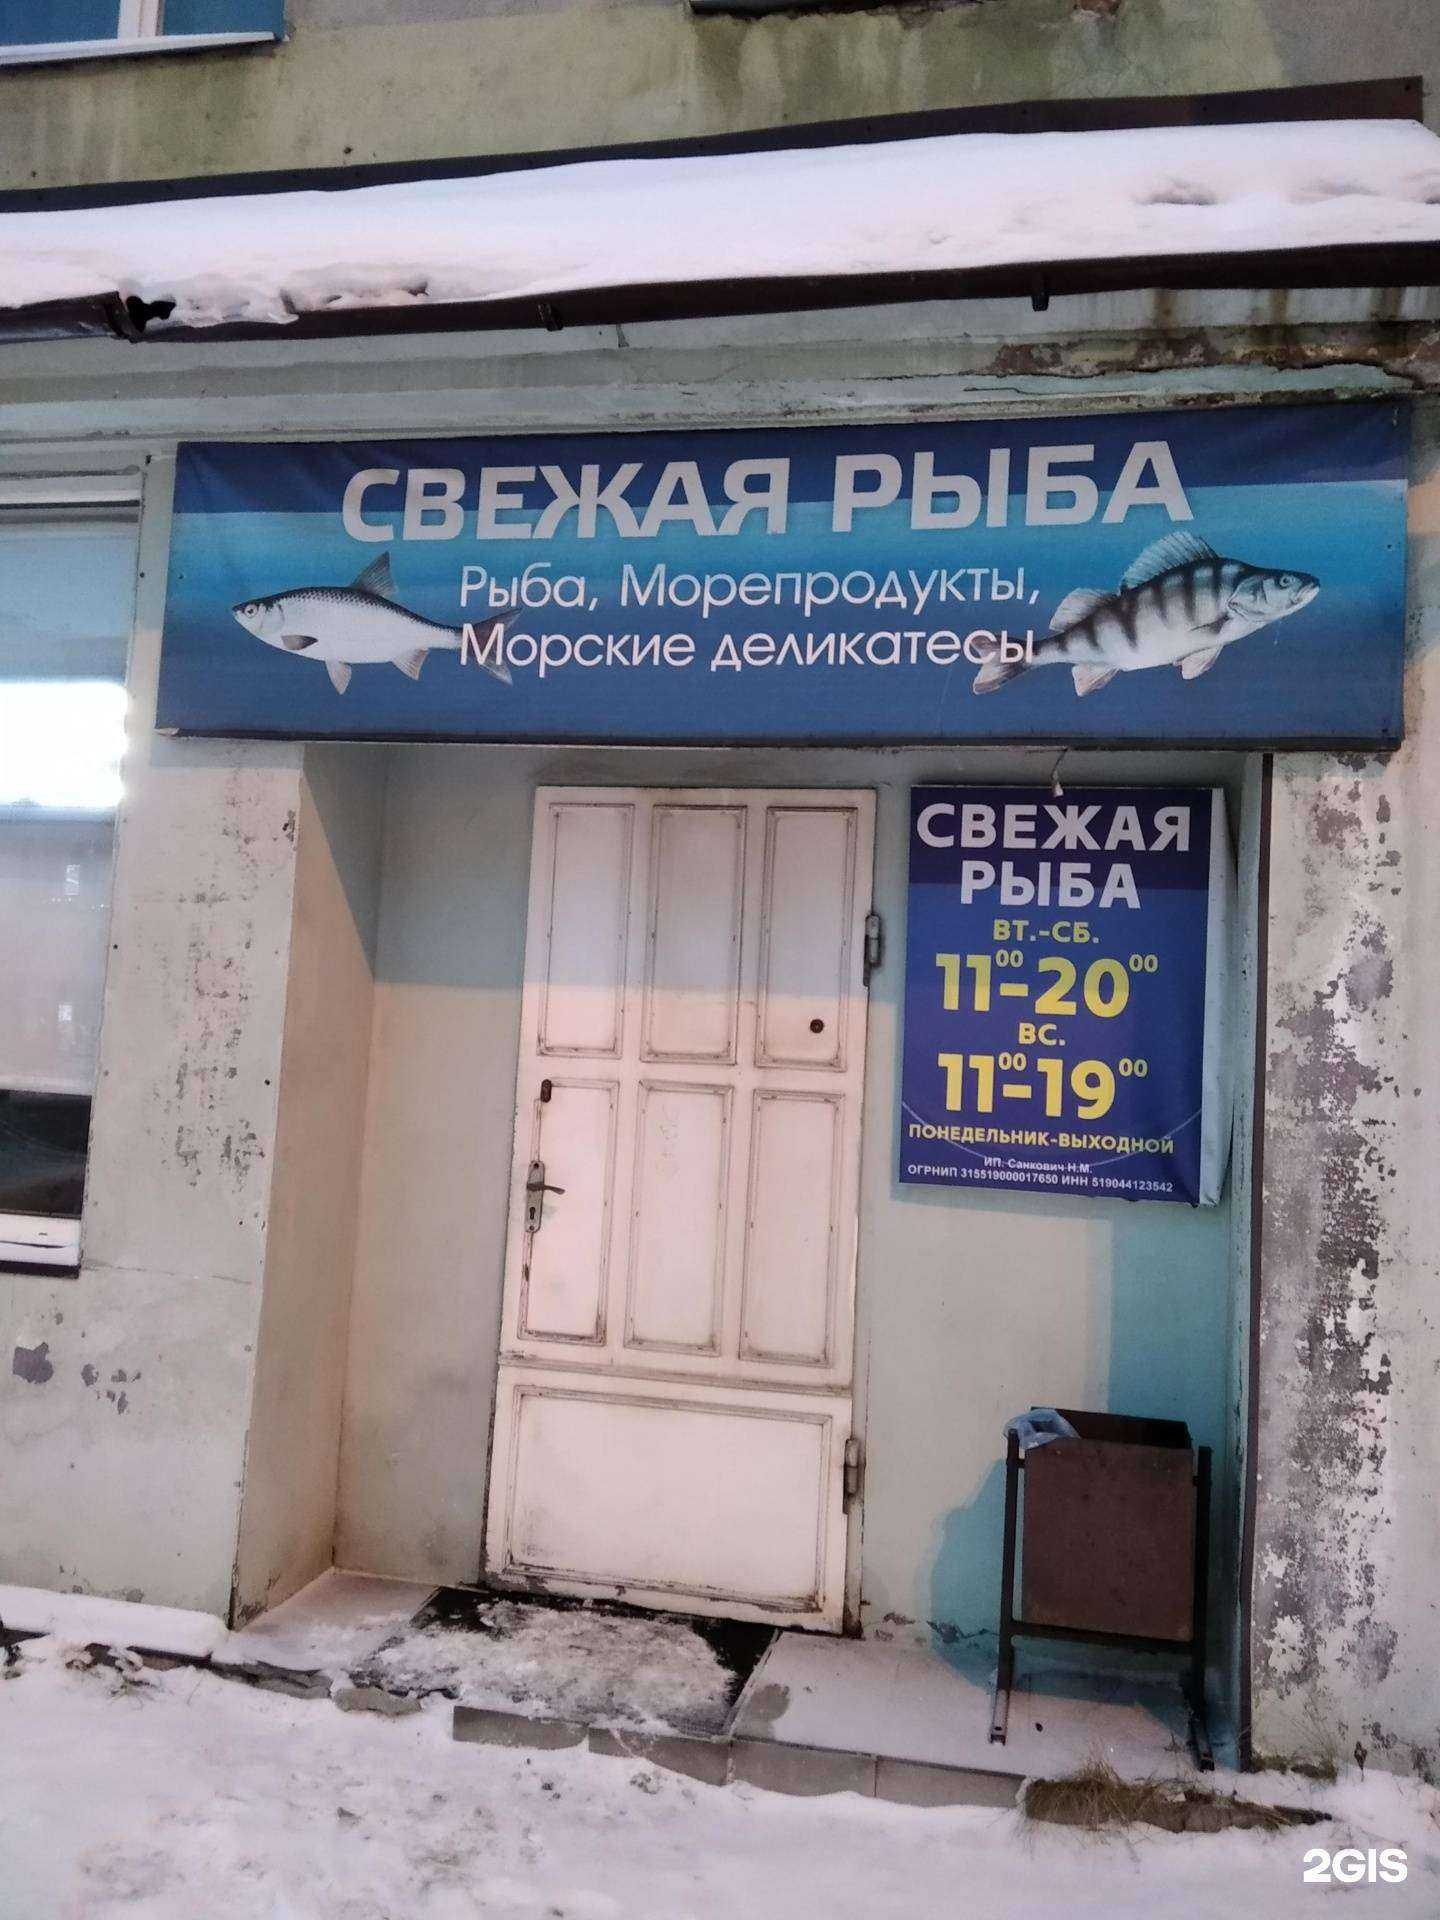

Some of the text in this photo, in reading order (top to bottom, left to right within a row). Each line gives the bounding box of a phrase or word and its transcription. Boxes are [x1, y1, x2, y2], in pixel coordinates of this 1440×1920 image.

[341, 440, 1195, 543] СВЕЖАЯ РЫБА
[459, 562, 1041, 618] Рыба, Морепродукты,
[459, 622, 1034, 678] Морские деликатесы
[916, 803, 1192, 852] СВЕЖАЯ
[960, 860, 1141, 909] РЫБА
[993, 919, 1100, 944] ВТ.-СБ.
[1018, 1022, 1066, 1046] ВС.
[908, 1123, 1175, 1155] ПОНЕДЕЛЬНИК-ВЫХОДНОЙ
[907, 1164, 1174, 1193] ОГРНИП 315519000017650 ИНН 519044123542
[1007, 1158, 1065, 1172] Санкович
